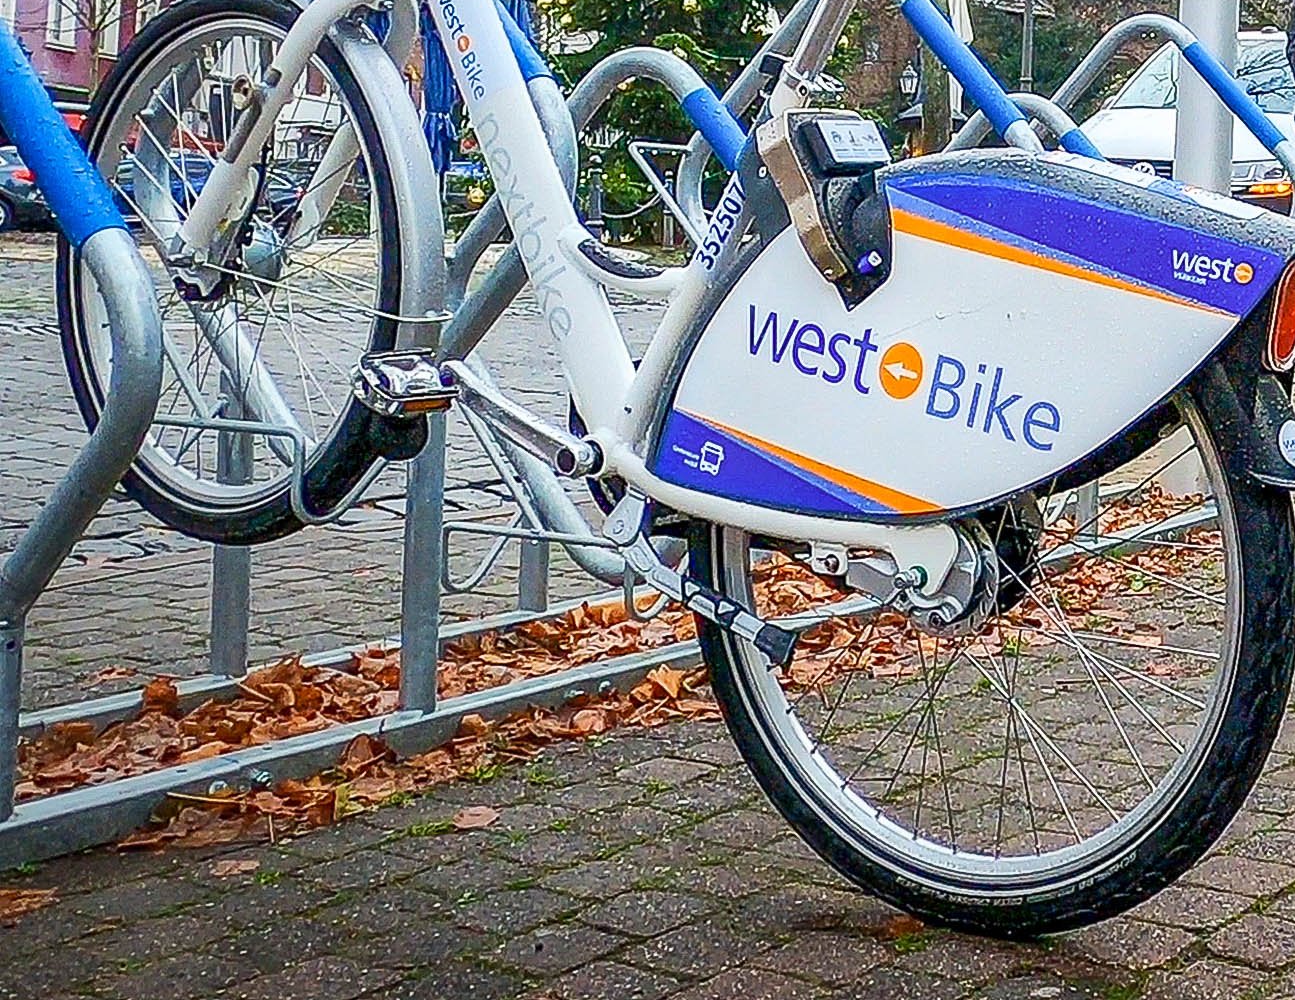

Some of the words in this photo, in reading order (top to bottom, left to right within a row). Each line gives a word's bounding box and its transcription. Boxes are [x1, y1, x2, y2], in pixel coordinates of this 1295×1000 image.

[461, 51, 485, 101] Bike
[476, 113, 572, 342] nextbike
[695, 181, 747, 271] 352507
[1172, 249, 1235, 283] west
[749, 304, 878, 394] west
[925, 353, 1061, 451] Bike
